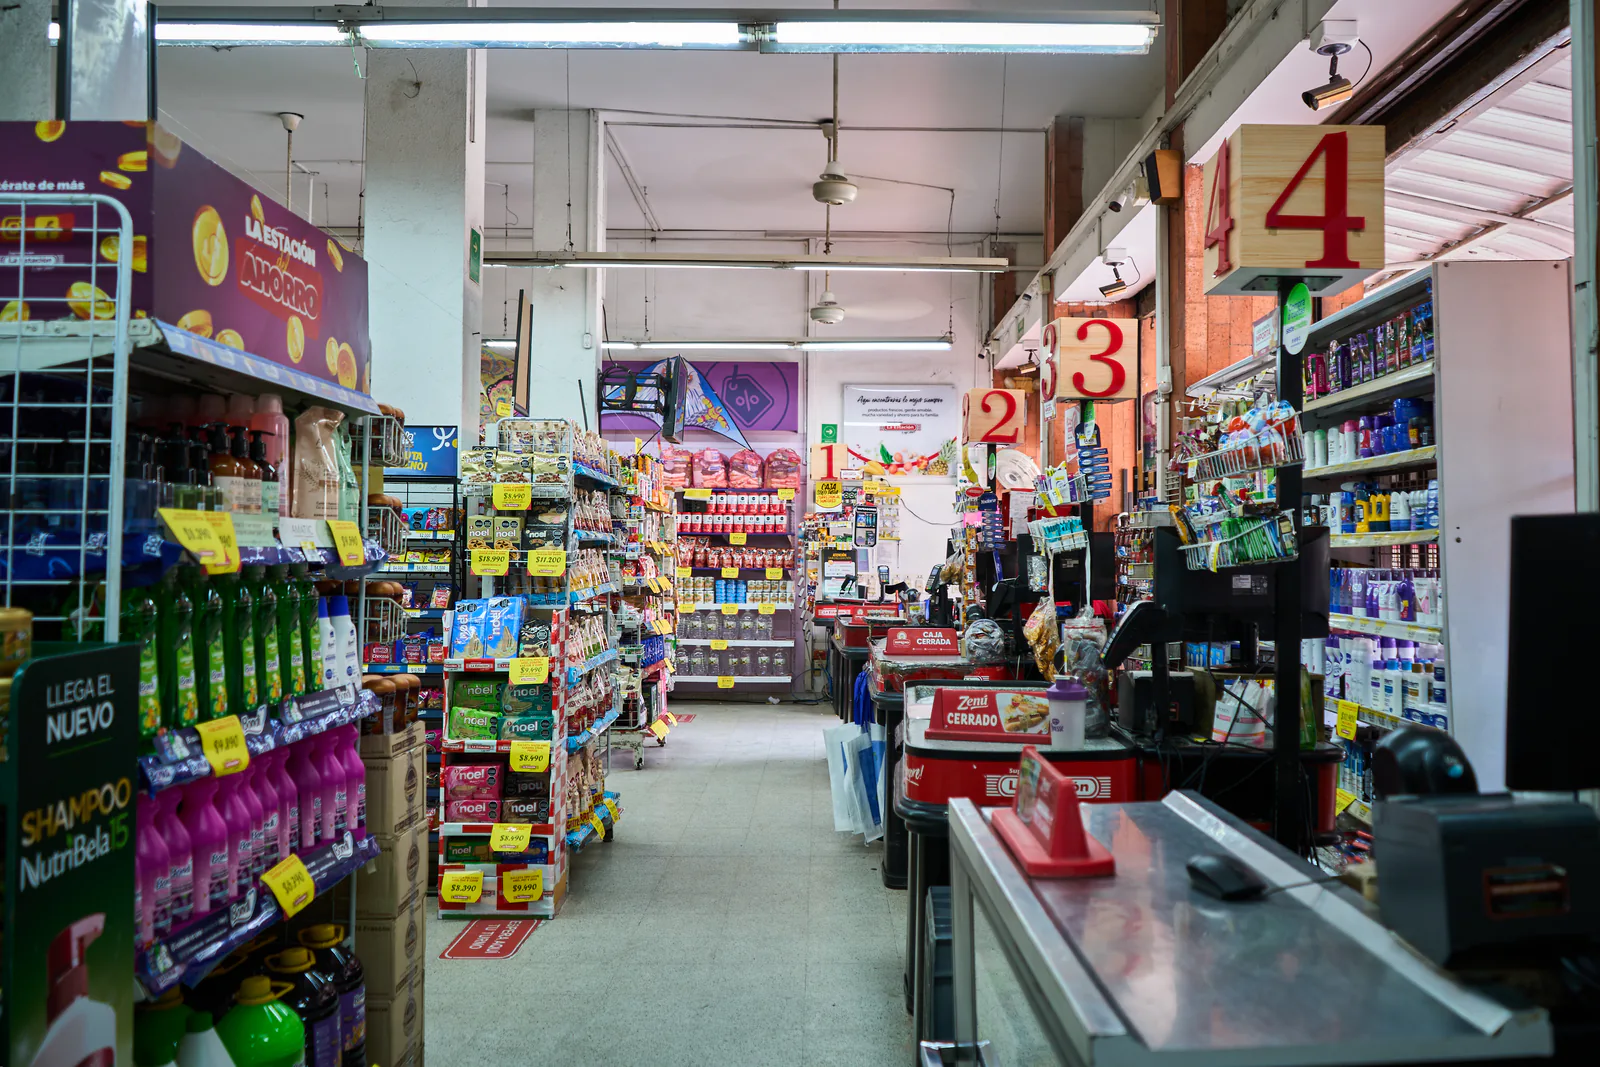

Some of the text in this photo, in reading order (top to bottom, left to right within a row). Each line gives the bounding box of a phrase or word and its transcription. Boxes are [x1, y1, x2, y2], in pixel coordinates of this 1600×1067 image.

[38, 179, 55, 190] de
[57, 178, 85, 190] más
[1266, 131, 1365, 268] 4
[1205, 138, 1234, 277] 4
[245, 215, 316, 267] LA ESTACIÓN
[241, 251, 319, 320] AHORRO
[1042, 324, 1057, 400] 3
[1072, 319, 1126, 397] 3
[980, 390, 1019, 442] 2
[821, 445, 838, 480] 1
[469, 529, 490, 537] noel
[496, 529, 516, 538] noel
[529, 530, 547, 538] noel
[478, 555, 505, 563] $18.990
[489, 609, 501, 635] noel
[47, 674, 115, 708] LLEGA EL
[468, 685, 493, 695] noel
[514, 686, 540, 696] noel
[957, 695, 988, 711] Zenú
[46, 701, 114, 744] NUEVO
[464, 716, 487, 726] noel
[947, 713, 998, 726] CERRADO
[512, 721, 538, 731] noel
[459, 768, 484, 780] noel
[518, 781, 543, 792] noel
[21, 776, 131, 848] SHAMPOO
[459, 803, 486, 813] noel
[511, 802, 537, 812] noel
[452, 846, 471, 855] noel
[450, 884, 477, 892] $8.390
[512, 884, 537, 892] $9.490
[499, 920, 522, 940] ESPERA
[469, 923, 501, 950] TU TURNO
